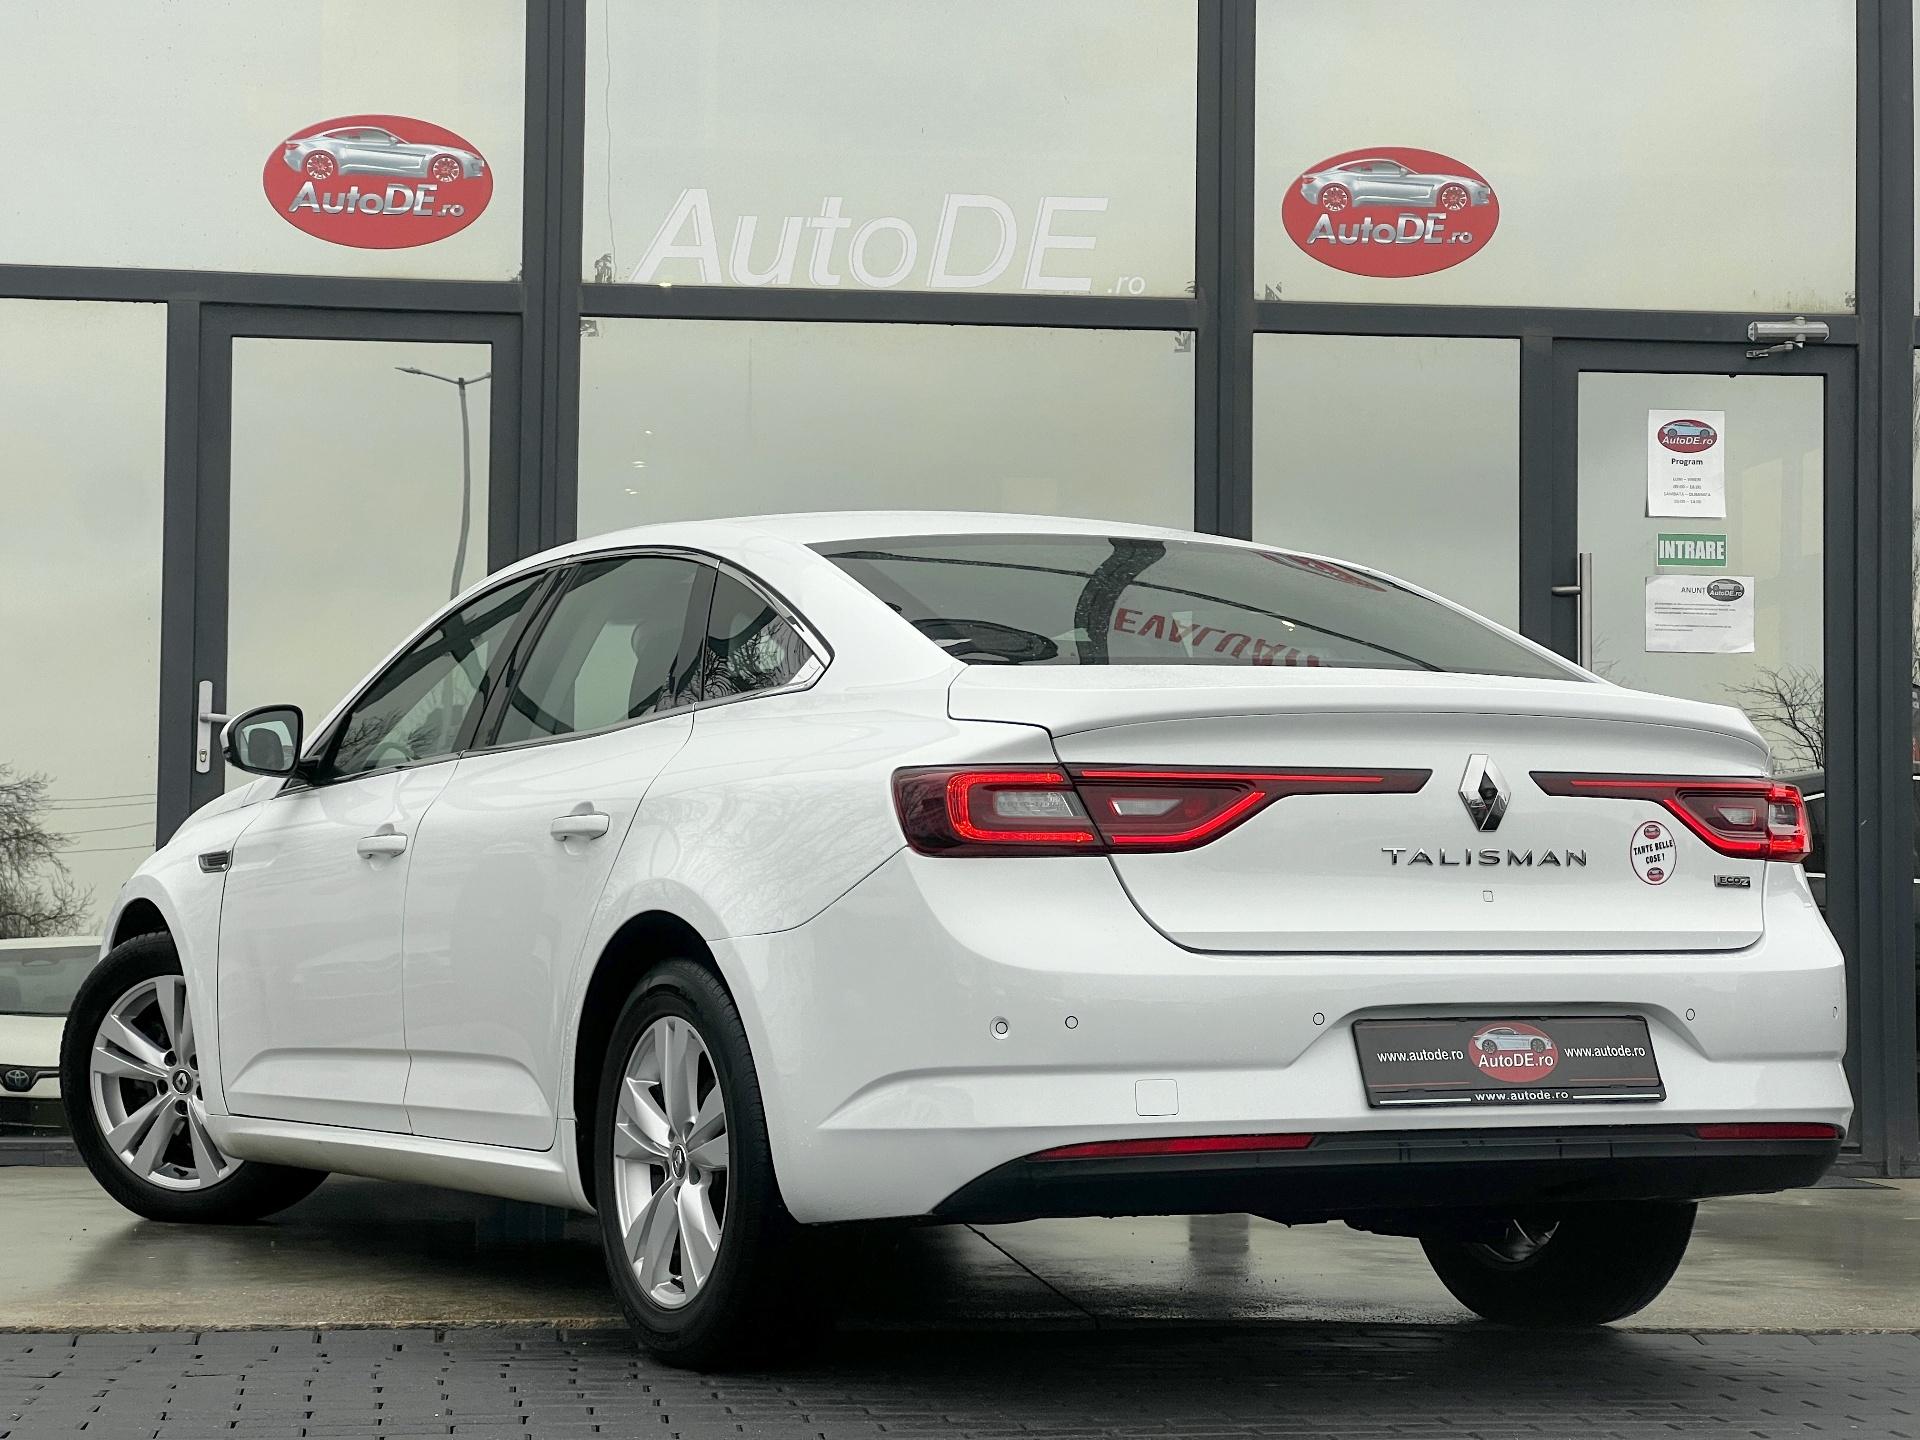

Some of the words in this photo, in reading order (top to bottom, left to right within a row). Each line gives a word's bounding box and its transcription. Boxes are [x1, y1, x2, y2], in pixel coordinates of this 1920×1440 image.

[1662, 436, 1713, 445] AutoDE.ro
[1671, 458, 1704, 467] Program
[1659, 540, 1725, 560] INTRARE
[1709, 589, 1742, 597] AutoDE.ro
[1633, 843, 1654, 856] TANTE
[1655, 839, 1674, 851] BELLE
[1381, 847, 1588, 868] TALISMAN
[1377, 1050, 1464, 1063] www.autode.ro
[1478, 1053, 1554, 1069] AutoDE.ro
[1564, 1045, 1646, 1058] www.autode.ro
[1475, 1090, 1569, 1101] www.autode.ro
